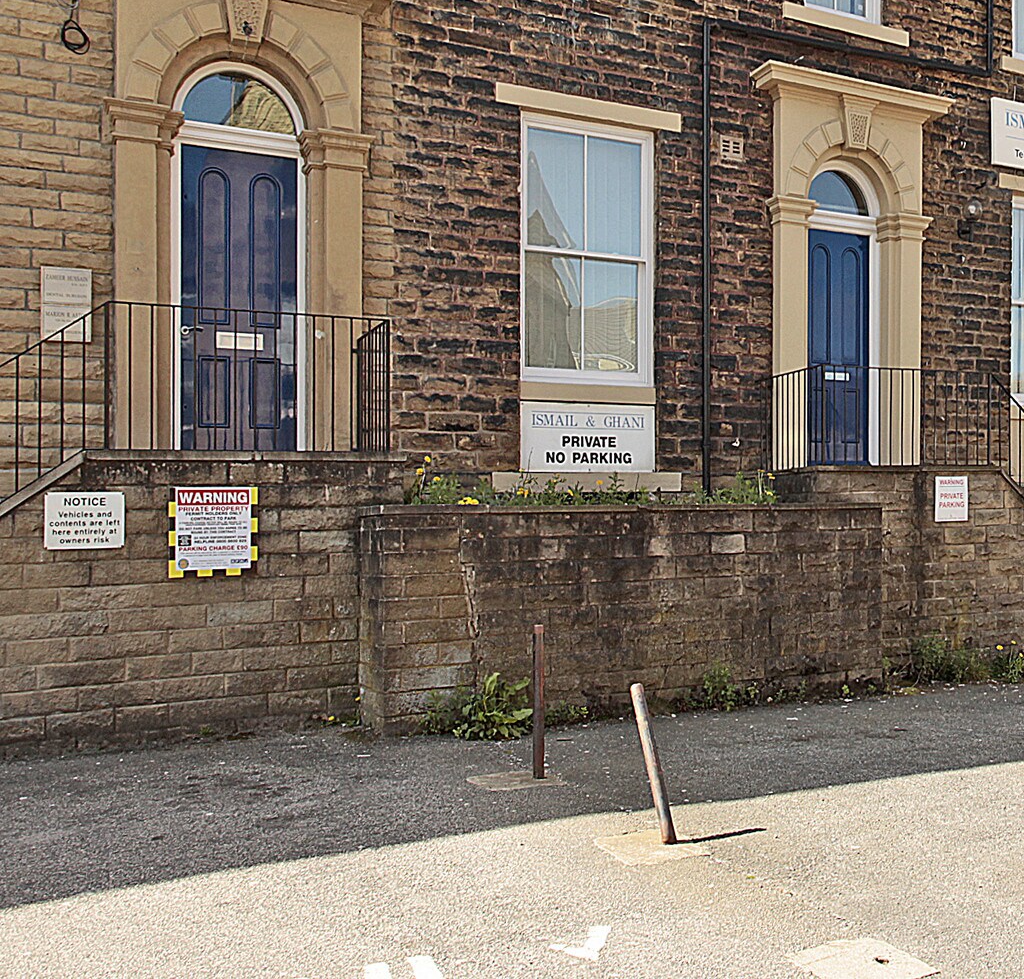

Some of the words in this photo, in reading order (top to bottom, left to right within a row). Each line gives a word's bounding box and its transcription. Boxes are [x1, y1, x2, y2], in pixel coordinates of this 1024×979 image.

[531, 413, 578, 427] ISMAIL
[585, 415, 596, 428] &
[603, 416, 645, 428] GHANI
[562, 435, 617, 448] PRIVATE
[545, 451, 566, 464] NO
[572, 452, 633, 465] PARKING
[179, 492, 248, 504] WARNING
[940, 492, 964, 500] PRIVATE
[64, 498, 106, 506] NOTICE
[74, 528, 106, 536] entirely
[94, 536, 110, 544] risk
